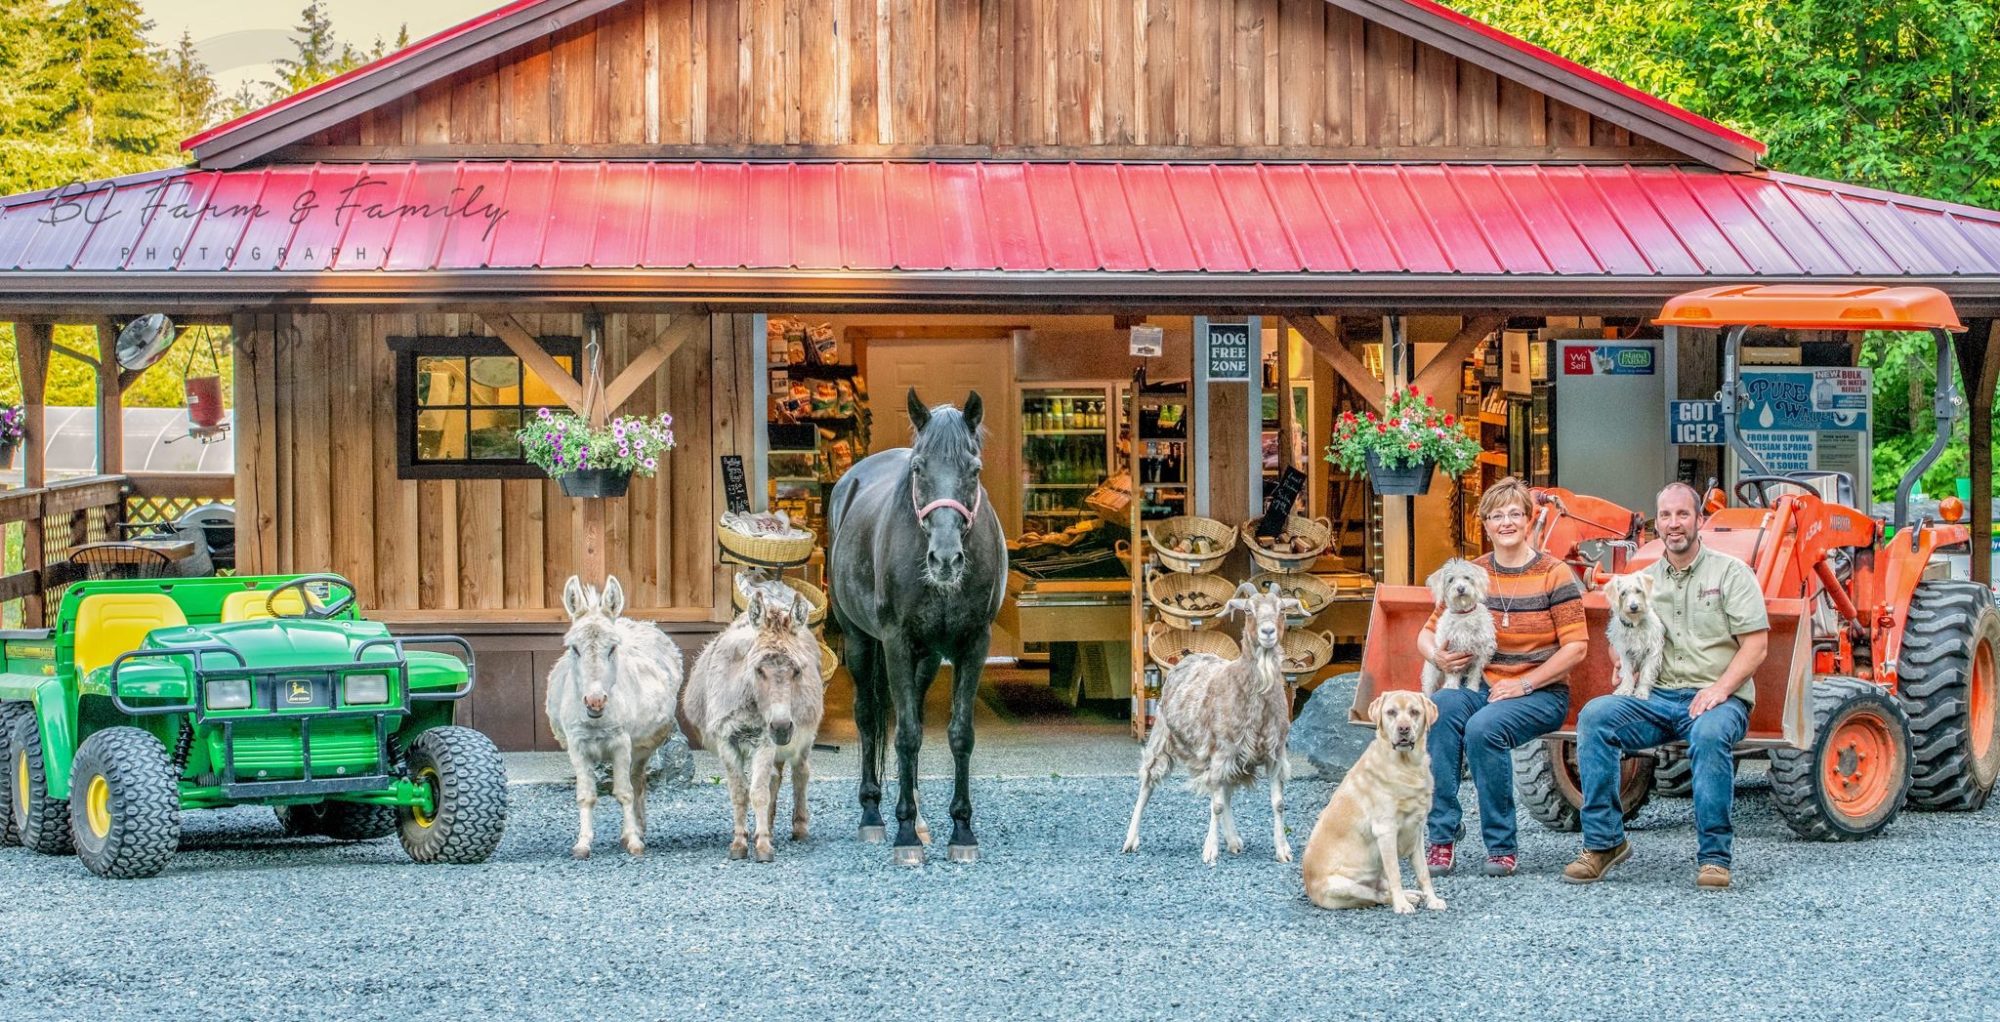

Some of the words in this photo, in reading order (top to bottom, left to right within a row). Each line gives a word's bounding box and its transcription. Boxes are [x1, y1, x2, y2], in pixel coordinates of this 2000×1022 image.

[1211, 333, 1246, 345] DOG
[1211, 347, 1246, 358] FREE
[1570, 353, 1587, 362] We
[1211, 361, 1246, 371] ZONE
[1570, 361, 1586, 370] Sell
[1841, 370, 1862, 379] BULK
[1748, 378, 1809, 403] PURE
[1679, 402, 1716, 422] GOT
[1677, 424, 1719, 444] ICE?
[1747, 434, 1770, 442] FROM
[1771, 434, 1788, 442] OUR
[1789, 434, 1809, 442] OWN
[1749, 443, 1781, 451] RTISIAN
[1783, 443, 1813, 451] SPRING
[1766, 452, 1808, 460] APPROVED
[1777, 462, 1809, 470] SOURCE
